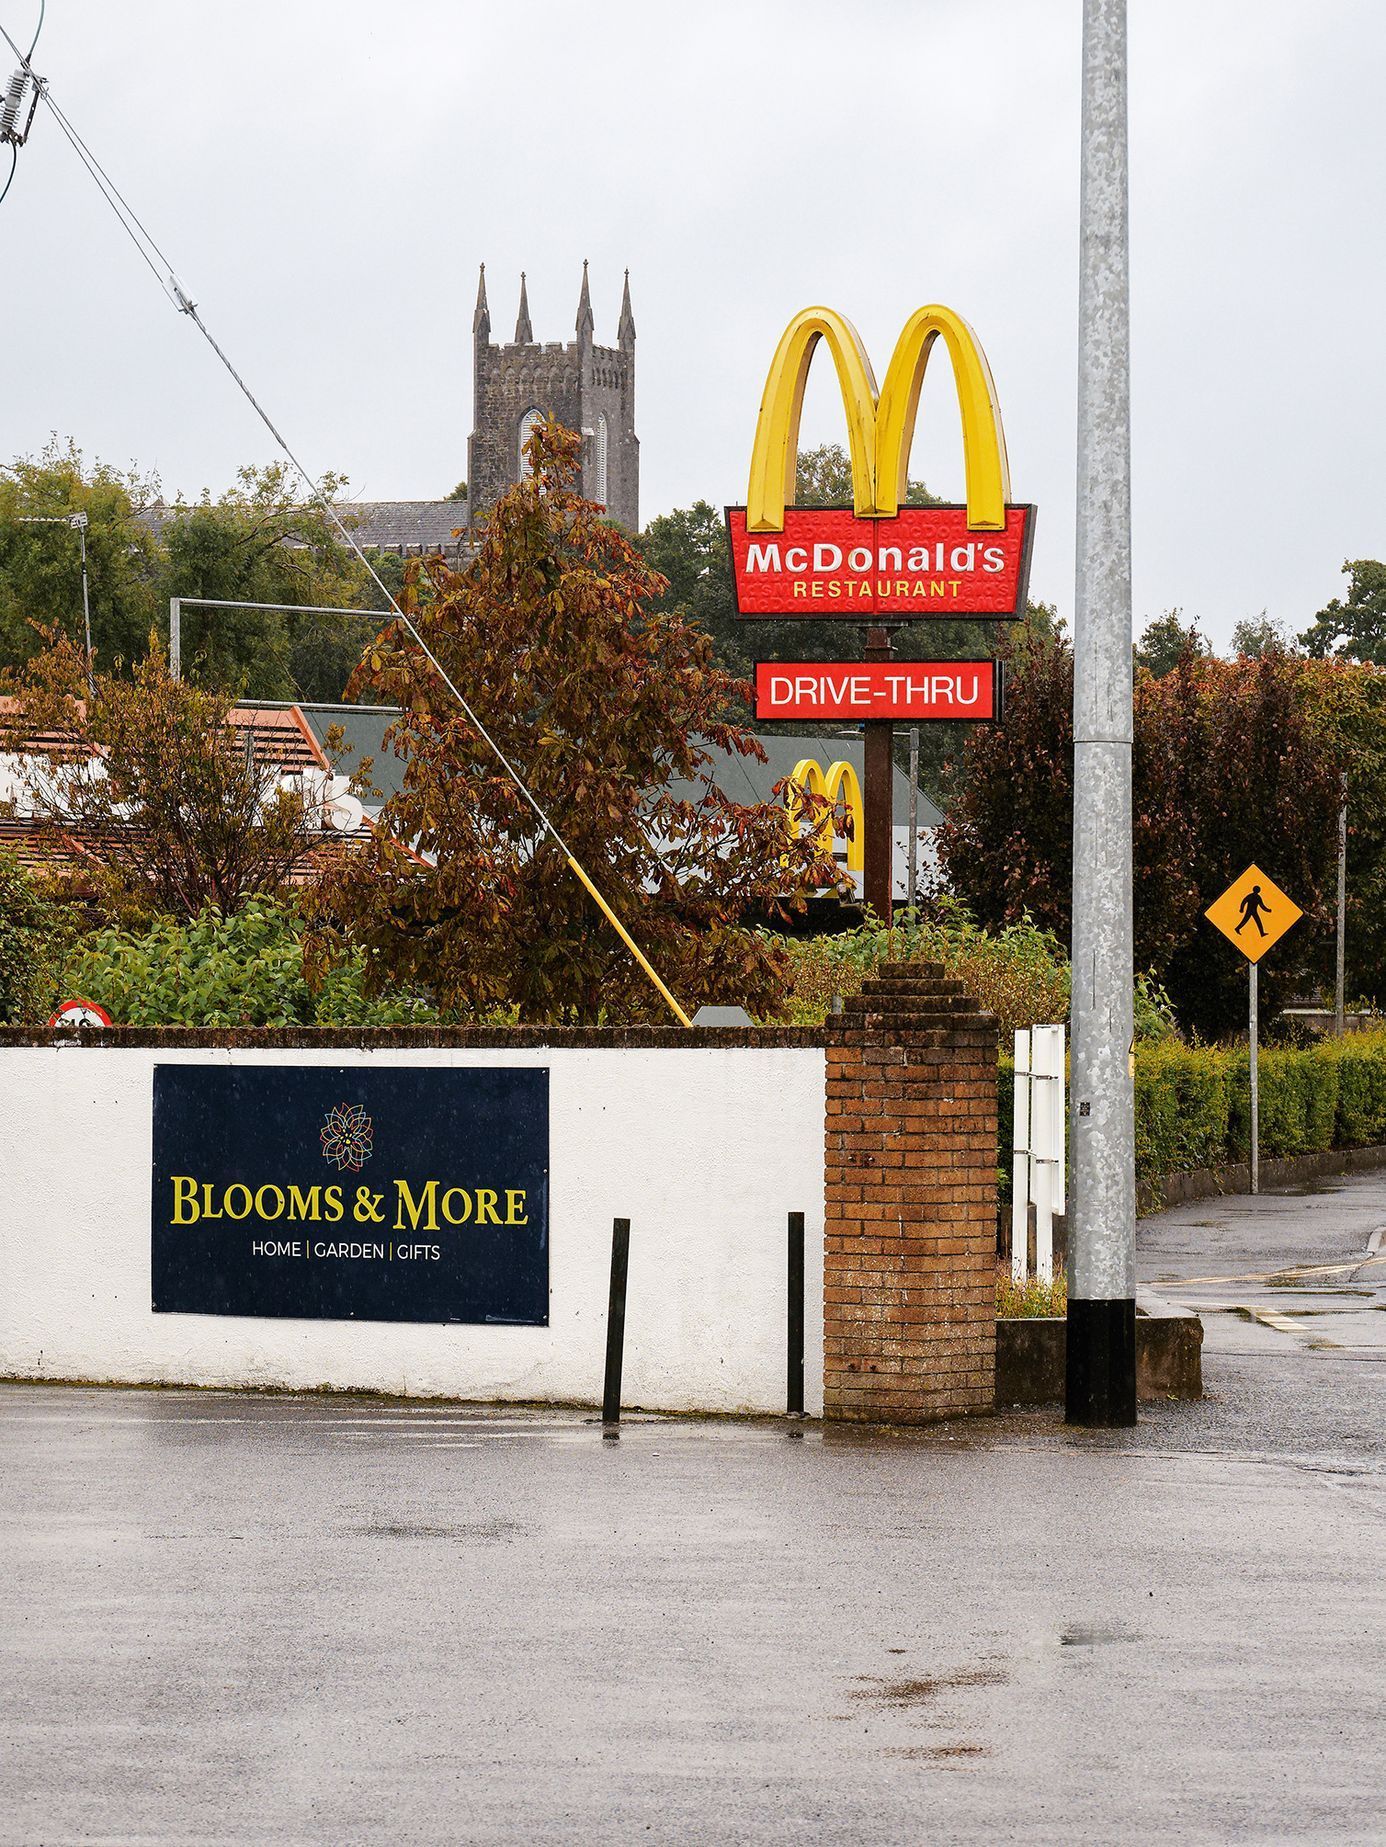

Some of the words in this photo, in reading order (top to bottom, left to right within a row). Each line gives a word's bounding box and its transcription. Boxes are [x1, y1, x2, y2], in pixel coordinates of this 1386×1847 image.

[745, 542, 1005, 573] McDonald's
[793, 580, 962, 598] RESTAURANT
[770, 675, 979, 705] DRIVE-THRU
[353, 1185, 386, 1223] &
[252, 1240, 302, 1257] HOME
[314, 1242, 384, 1259] GARDEN
[396, 1244, 441, 1261] GIFTS
